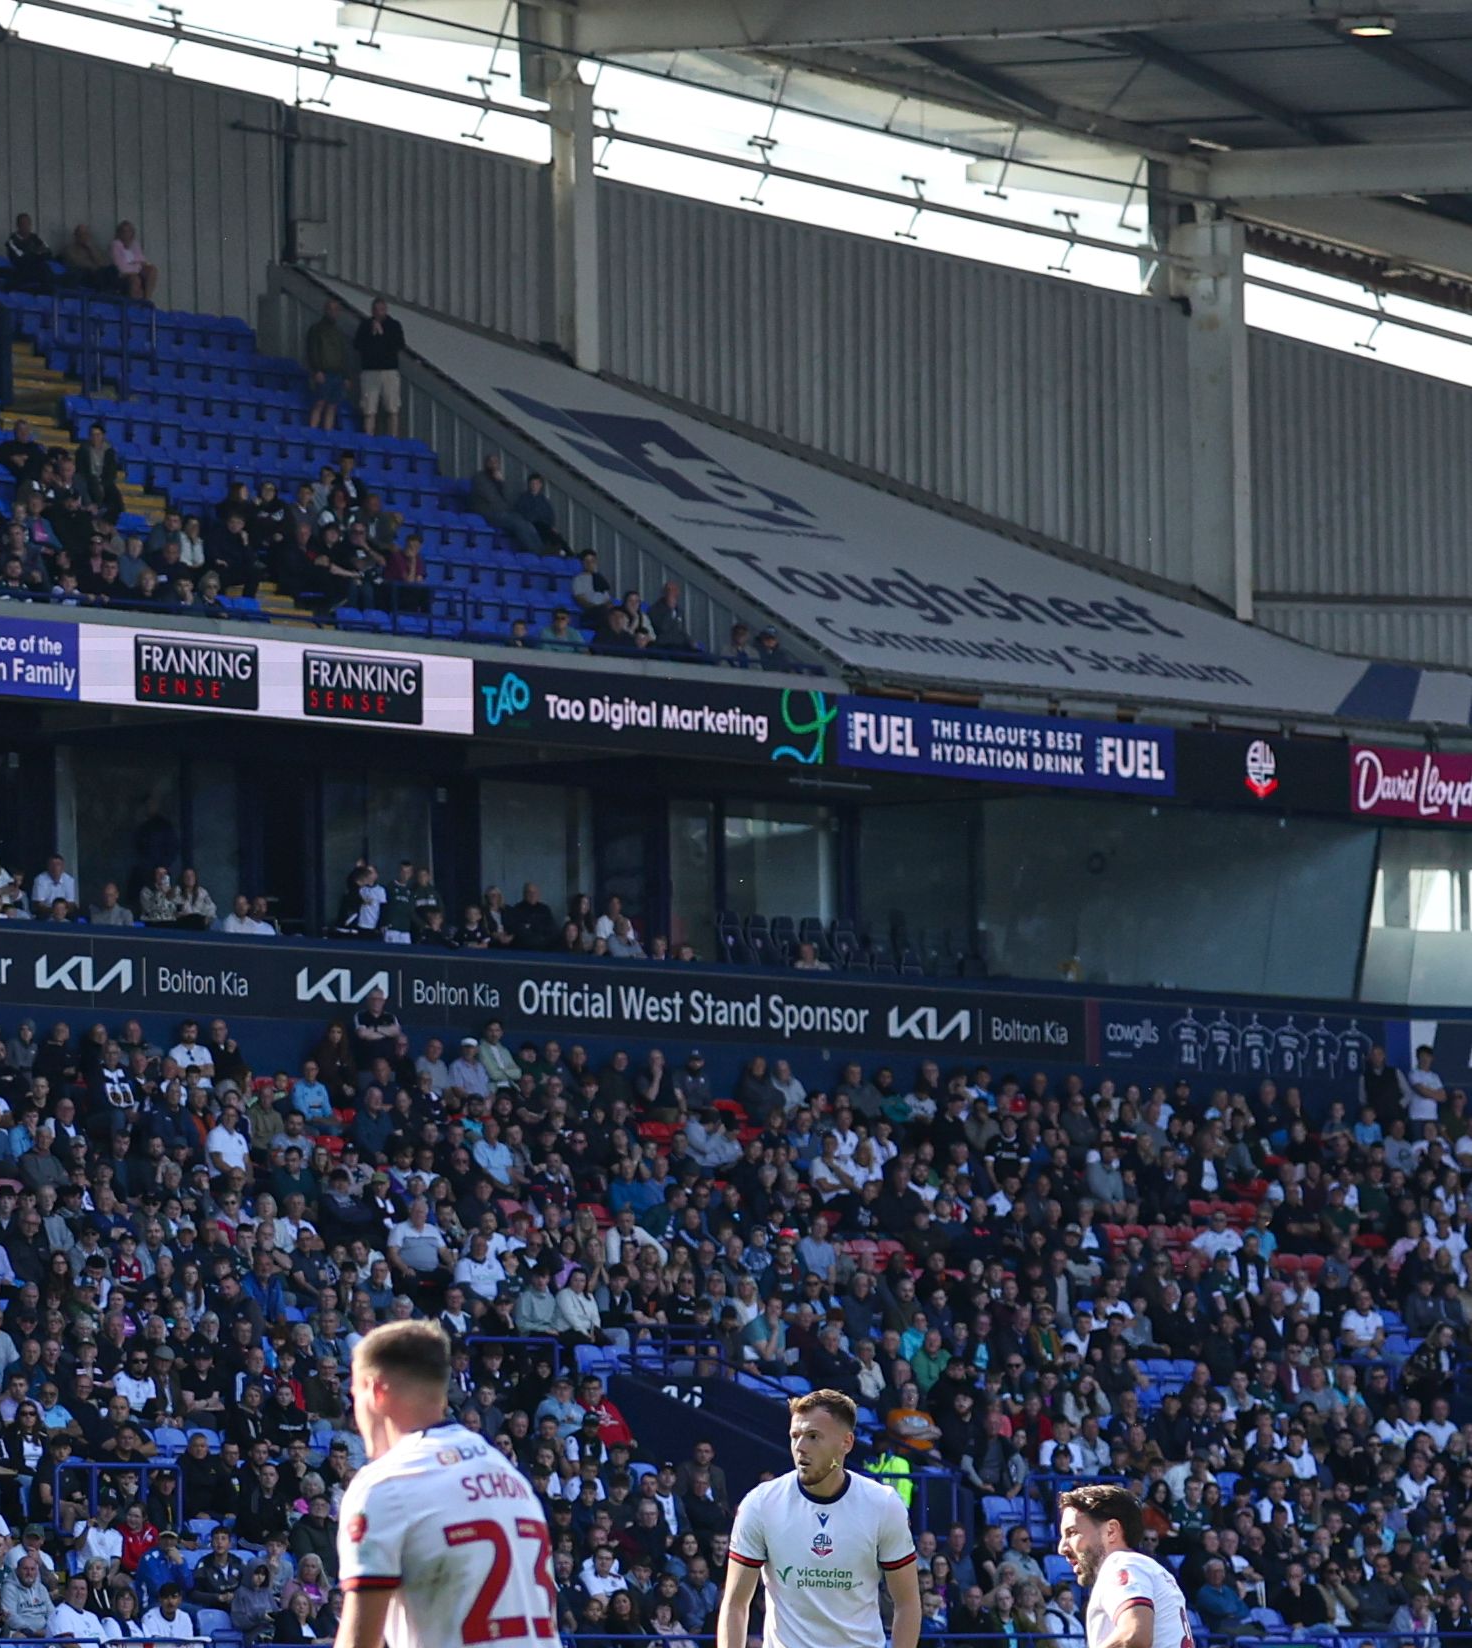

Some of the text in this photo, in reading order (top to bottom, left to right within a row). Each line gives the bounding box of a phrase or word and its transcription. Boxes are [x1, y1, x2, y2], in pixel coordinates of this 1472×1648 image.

[714, 547, 1185, 638] Toughsheet
[19, 634, 38, 653] of
[39, 637, 62, 656] the
[141, 644, 252, 681] FRANKING
[817, 618, 1253, 688] Community Stadium
[12, 657, 76, 691] Family
[141, 675, 221, 700] SENSE
[310, 659, 416, 696] FRANKING
[310, 690, 386, 715] SENSE
[545, 694, 768, 743] Tao Digital Marketing
[854, 711, 919, 757] FUEL
[931, 719, 1082, 752] THE LEAGUE'S BEST
[931, 743, 1028, 771] HYDRATION
[1033, 754, 1084, 775] DRINK
[1101, 737, 1165, 780] FUEL
[1355, 750, 1418, 810] David
[35, 954, 248, 997] KIA Bolton Kia
[413, 979, 469, 1006] Bolton
[474, 983, 500, 1009] Kia
[518, 979, 869, 1038] Official West Stand Sponsor
[888, 1006, 1069, 1045] KIA Bolton Kia
[1107, 1018, 1159, 1048] cowgills
[444, 1517, 556, 1646] 23
[797, 1567, 853, 1579] victorian
[797, 1578, 852, 1591] plumbing
